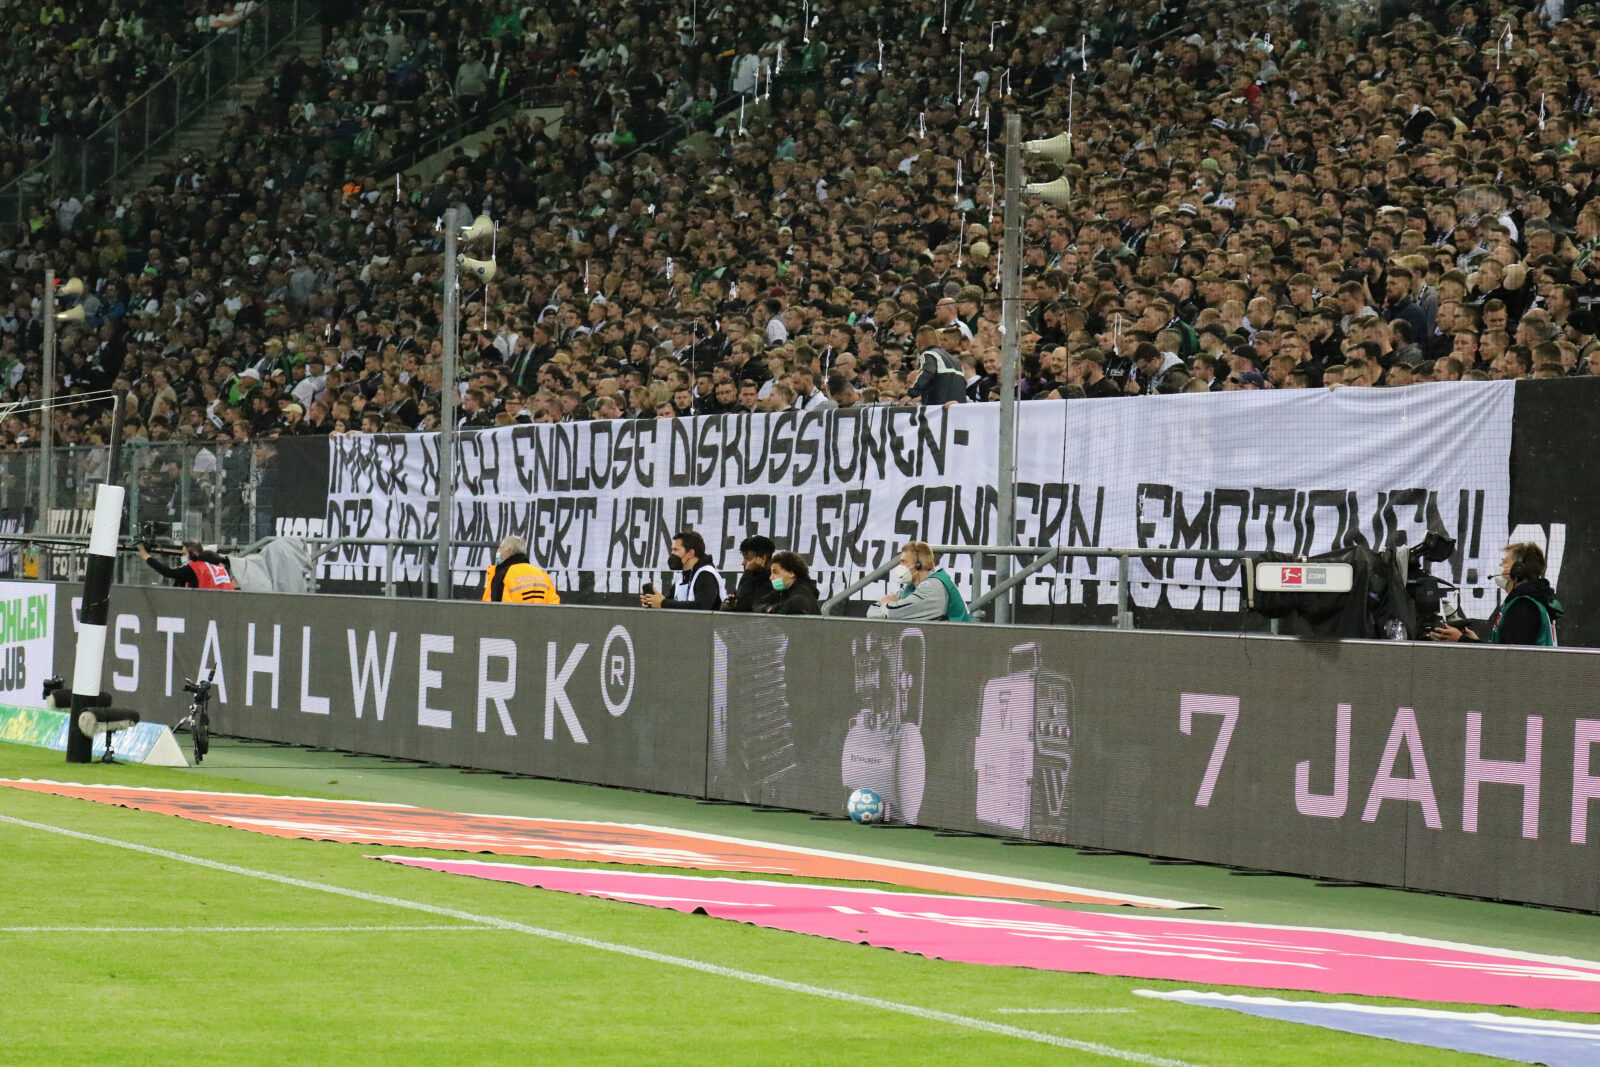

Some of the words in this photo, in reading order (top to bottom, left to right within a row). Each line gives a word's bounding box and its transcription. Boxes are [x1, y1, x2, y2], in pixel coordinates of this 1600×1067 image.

[329, 434, 407, 495] IMMER
[511, 420, 656, 494] ENDLOSE
[325, 499, 373, 563] DER
[1179, 692, 1240, 807] 7
